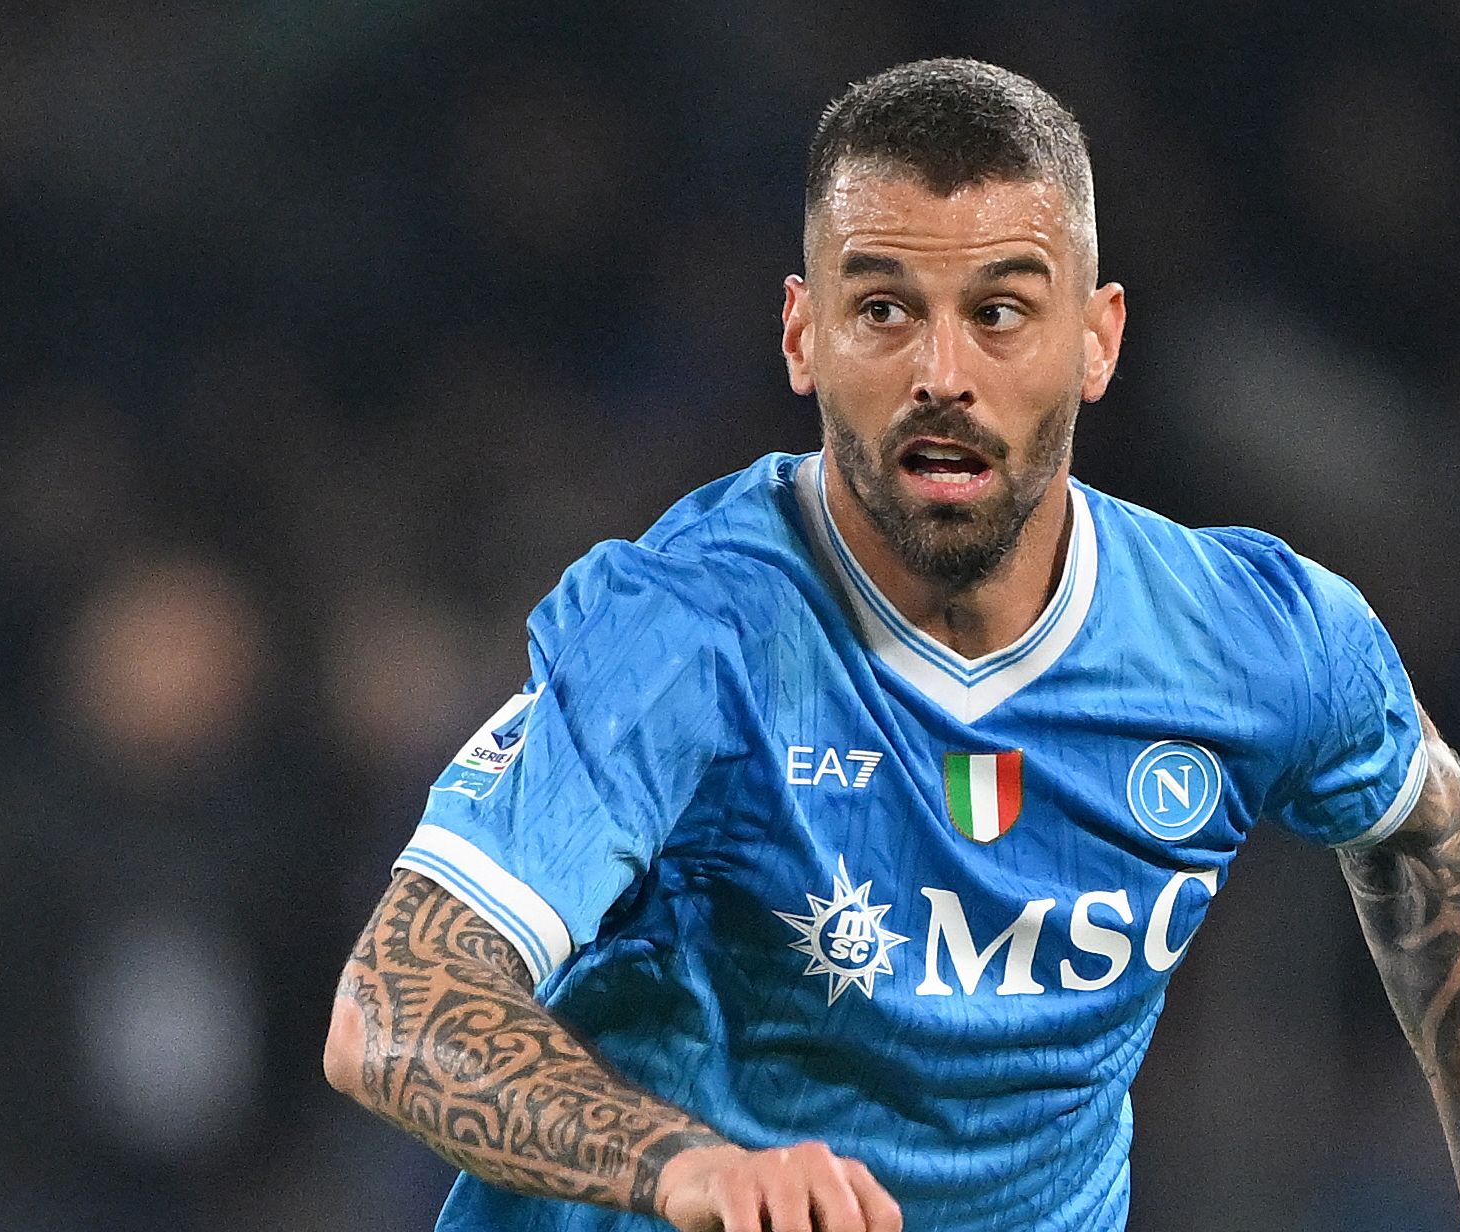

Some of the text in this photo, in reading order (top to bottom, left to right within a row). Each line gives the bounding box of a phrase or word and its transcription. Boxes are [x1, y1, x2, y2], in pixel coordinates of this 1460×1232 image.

[471, 746, 507, 764] SERIE
[787, 746, 883, 788] EA7
[1152, 765, 1192, 813] N
[915, 868, 1219, 996] MSC
